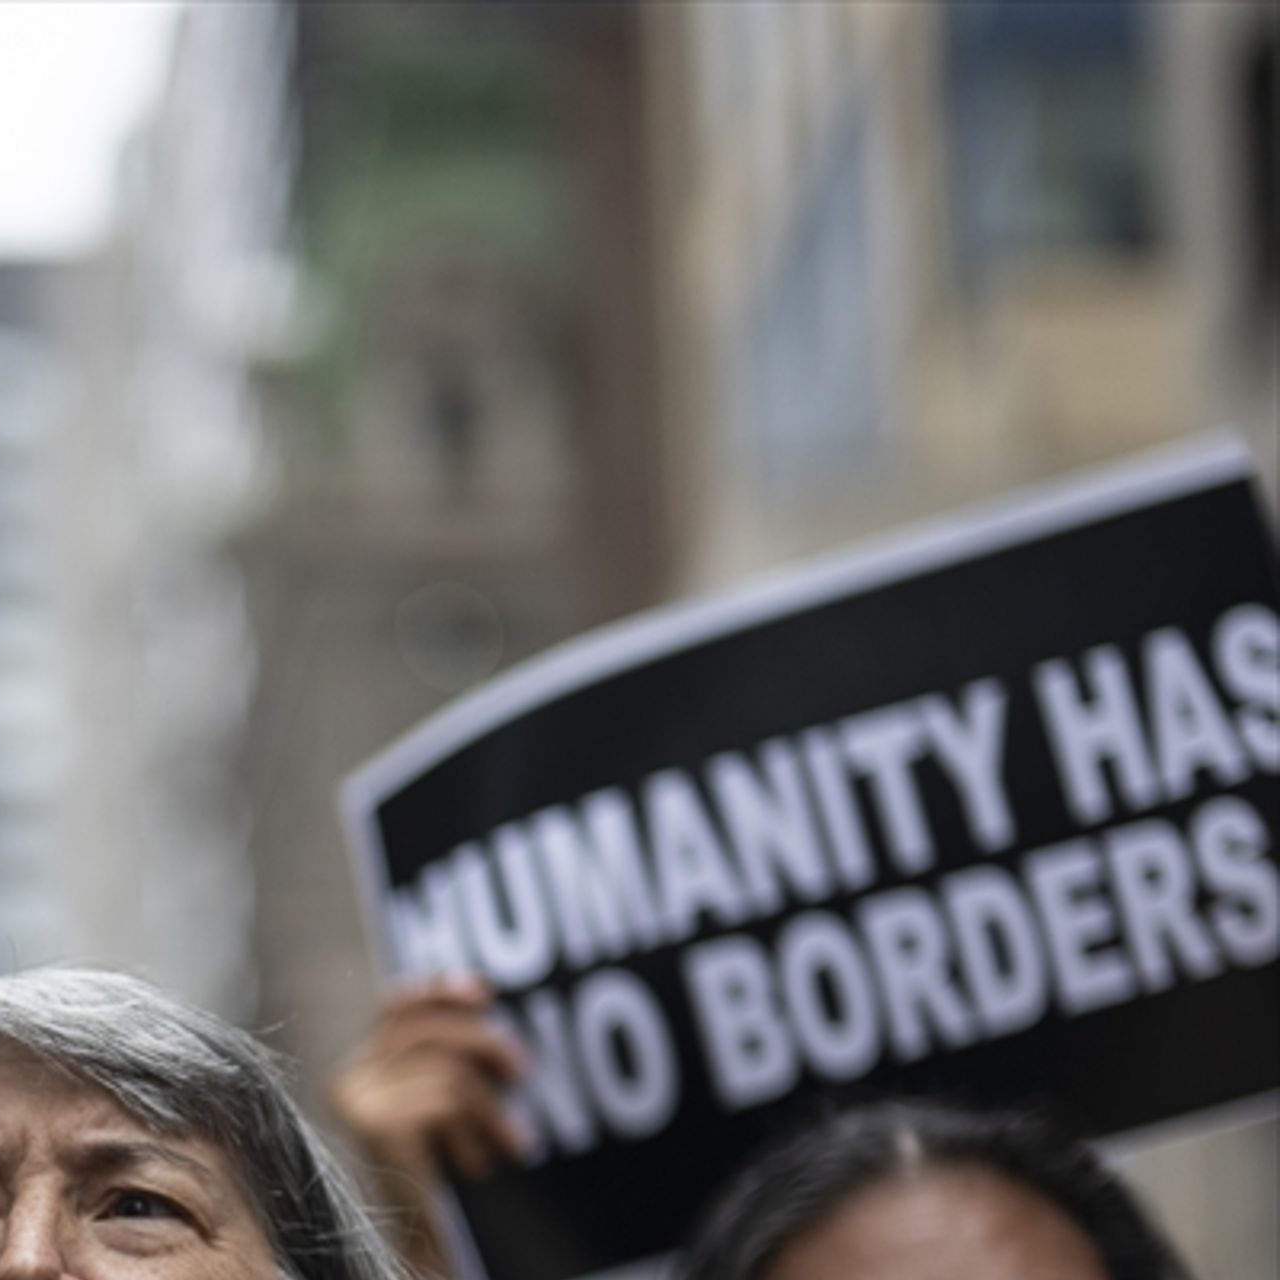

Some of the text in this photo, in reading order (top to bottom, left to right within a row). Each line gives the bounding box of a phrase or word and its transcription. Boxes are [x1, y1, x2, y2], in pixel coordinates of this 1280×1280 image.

[387, 602, 1280, 991] HUMANITY HAS
[684, 795, 1280, 1110] BORDERS
